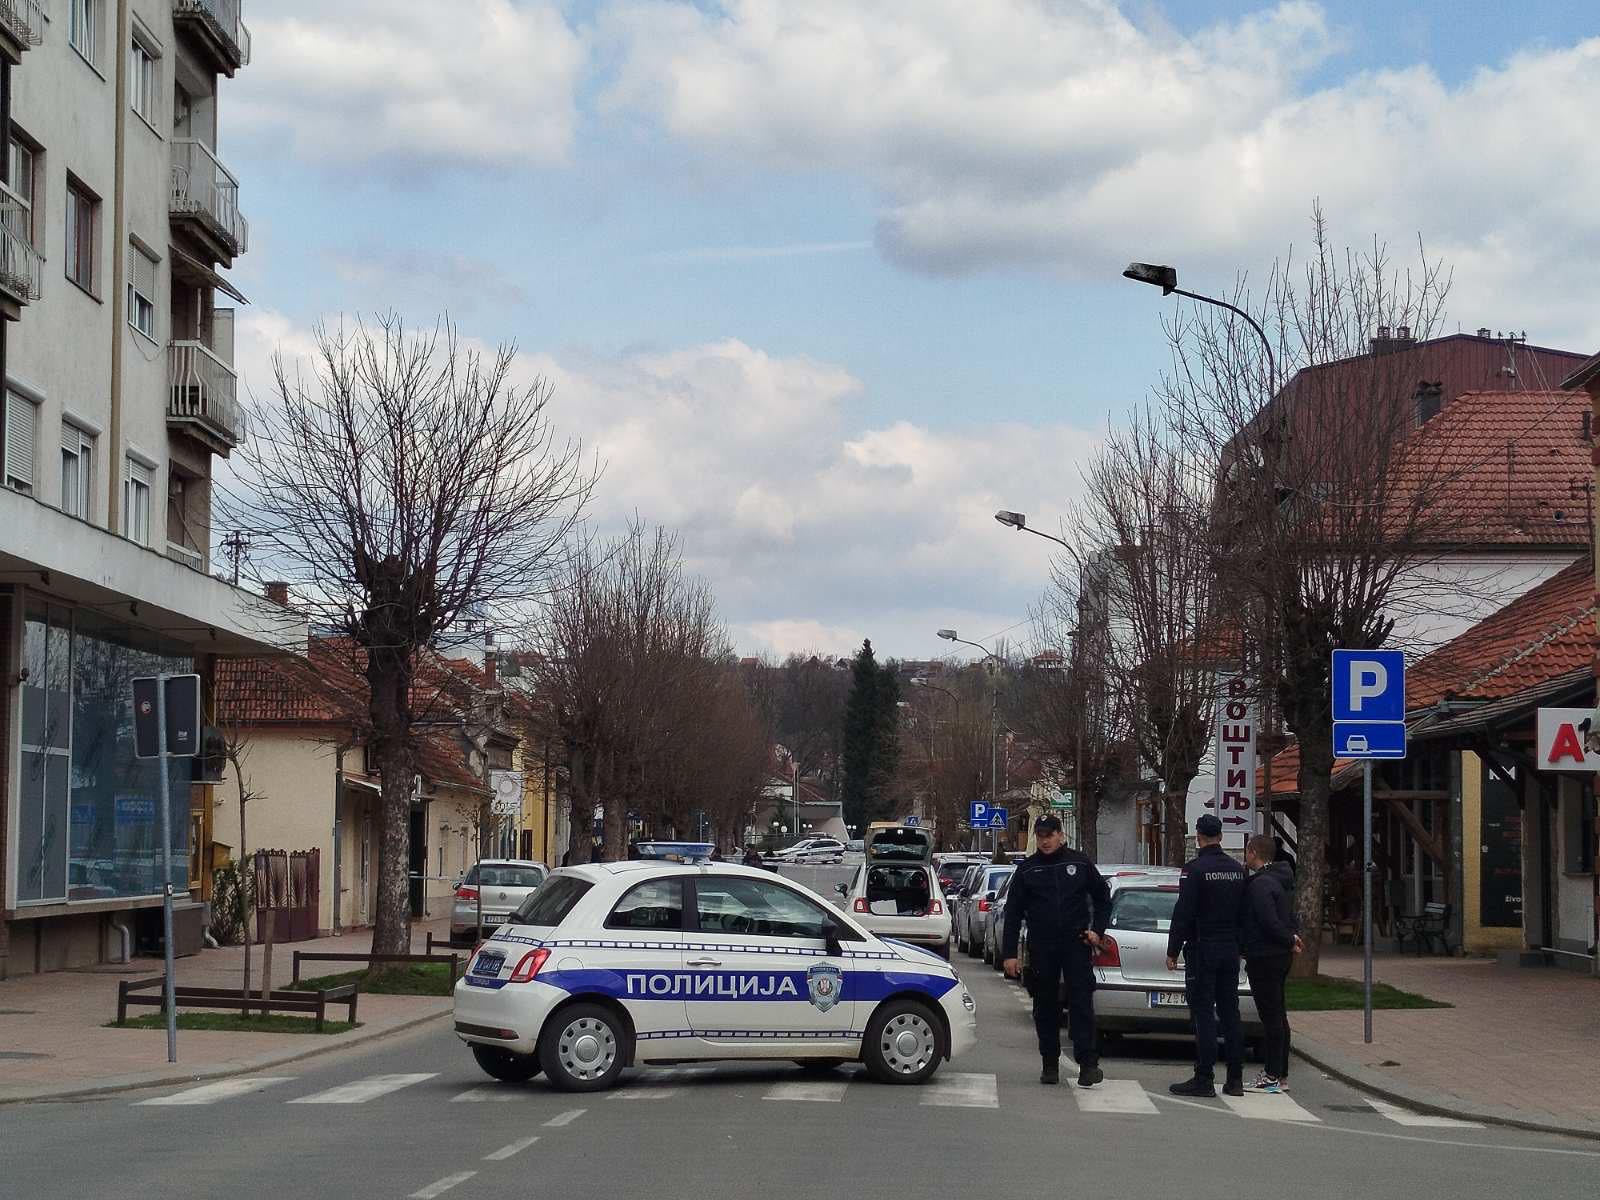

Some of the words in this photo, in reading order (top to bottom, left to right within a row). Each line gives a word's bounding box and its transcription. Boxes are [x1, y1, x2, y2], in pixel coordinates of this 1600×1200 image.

[1349, 660, 1388, 712] P
[1220, 678, 1251, 811] РОШТИЉ
[975, 803, 986, 818] P
[626, 974, 798, 999] ПОЛИЦИЈА
